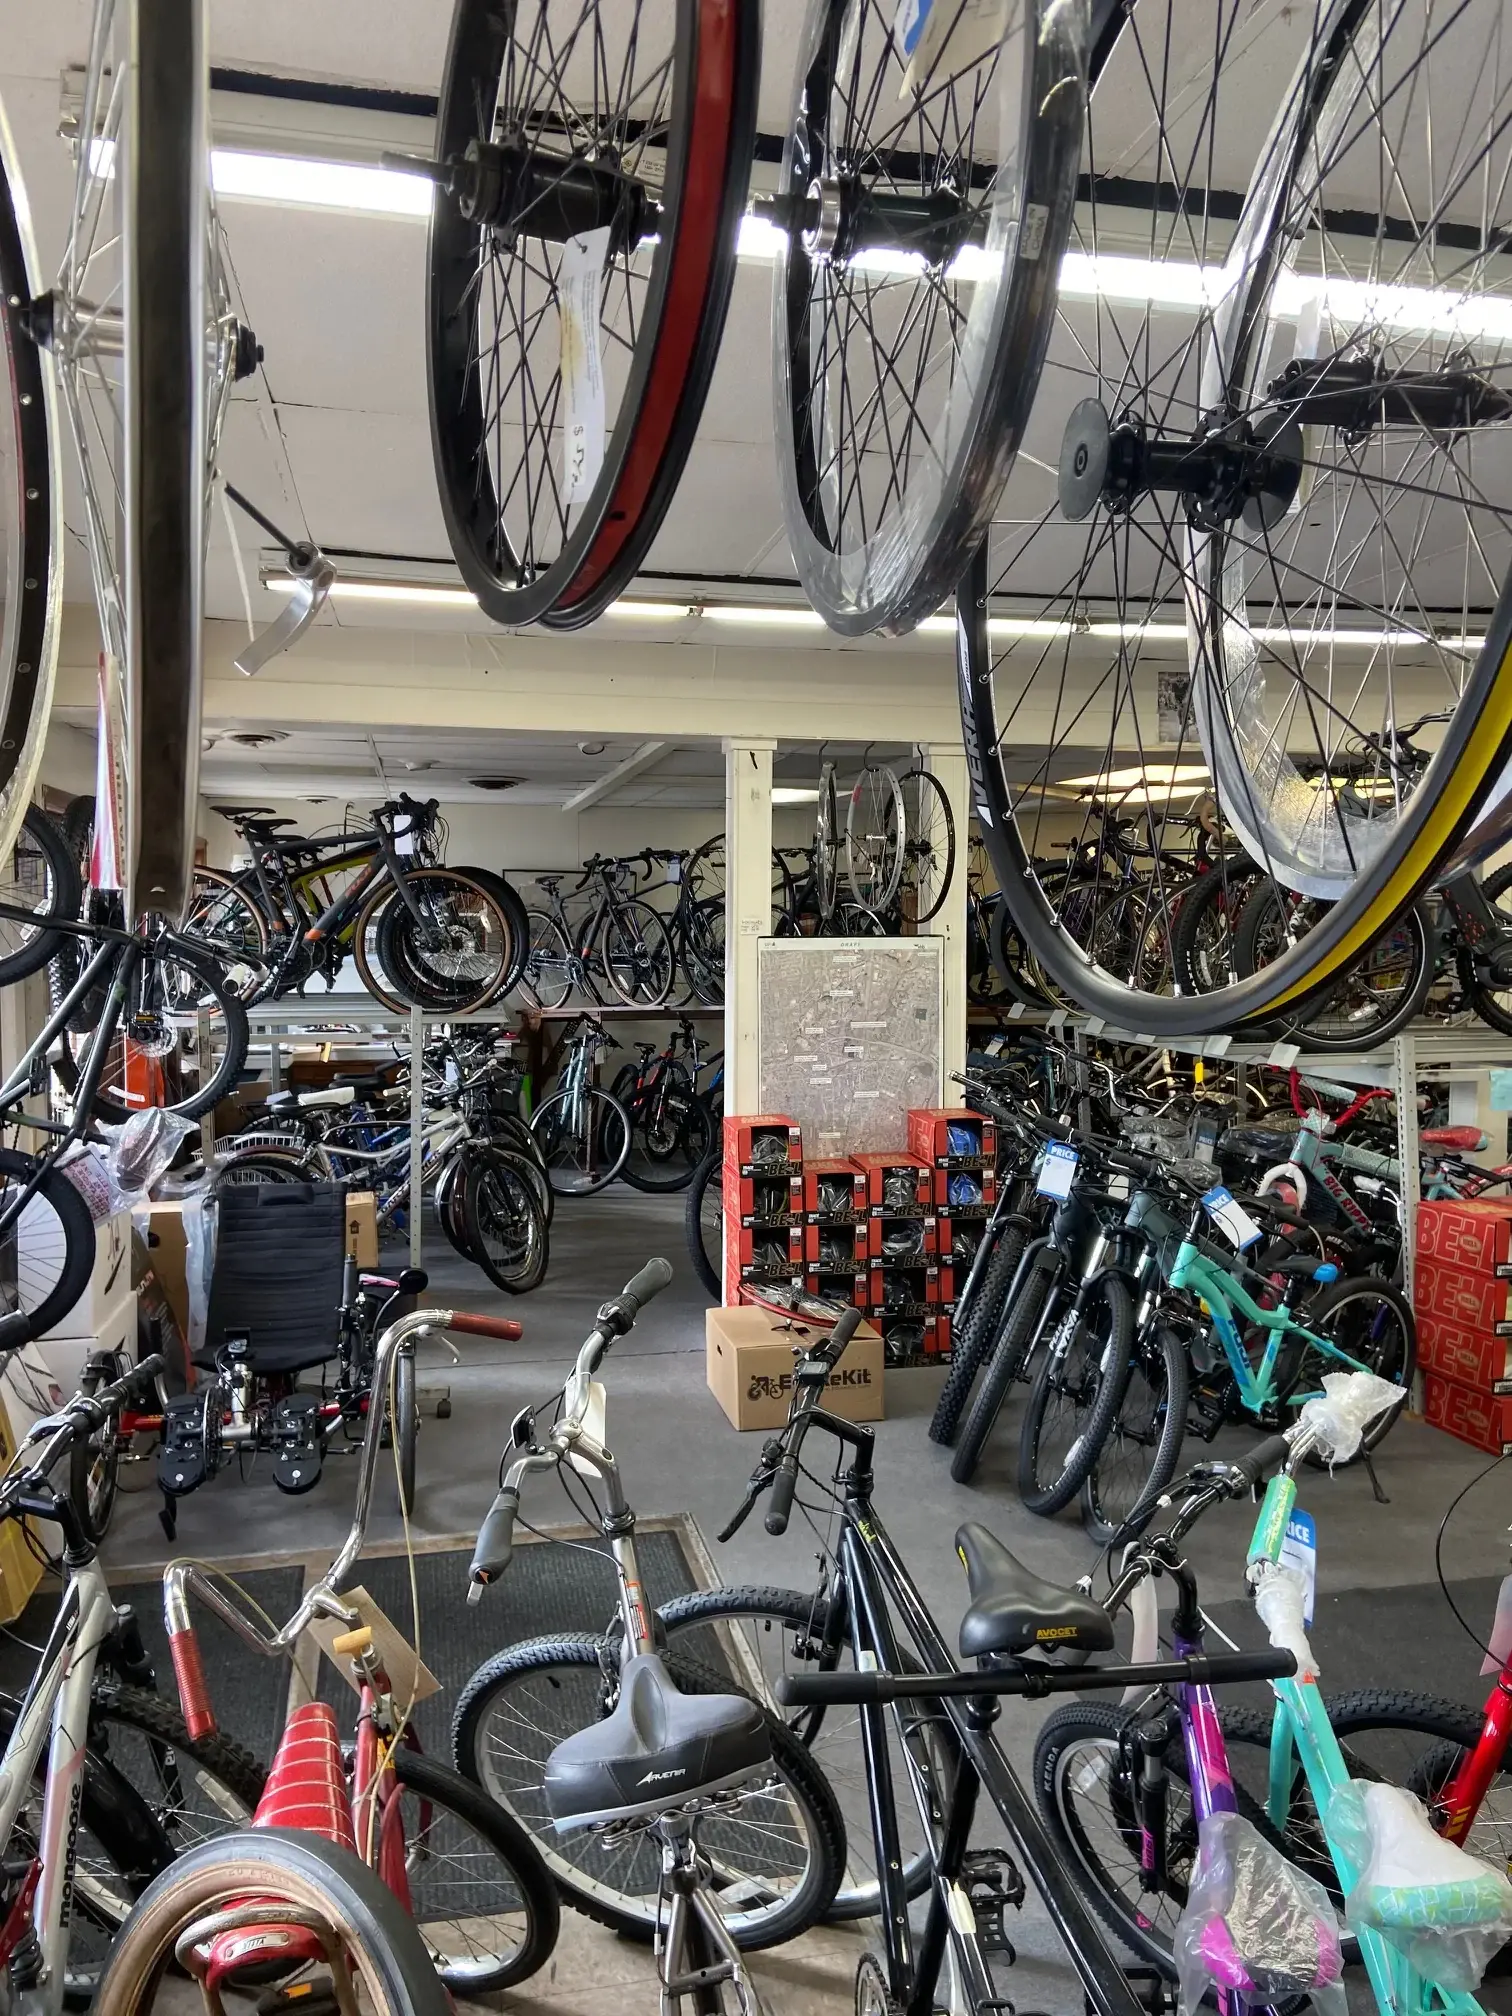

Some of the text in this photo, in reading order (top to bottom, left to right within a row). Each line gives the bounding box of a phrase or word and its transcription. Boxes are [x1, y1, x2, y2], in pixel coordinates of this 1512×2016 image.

[1050, 1146, 1076, 1160] PRICE
[768, 1162, 801, 1176] BELL
[1323, 1176, 1345, 1198] BIG
[769, 1213, 803, 1227] BELL
[833, 1210, 867, 1224] BELL
[1417, 1206, 1496, 1274] BELL
[834, 1261, 868, 1274] BELL
[904, 1254, 936, 1267] BELL
[768, 1263, 803, 1277] BELL
[1415, 1261, 1496, 1333] BELL
[1416, 1316, 1494, 1392] BELL
[1426, 1373, 1502, 1454] BELL
[1036, 1626, 1077, 1640] AVOCET
[636, 1768, 686, 1787] AVENIR
[1044, 1747, 1060, 1792] KENDA
[59, 1782, 81, 1929] mongoose
